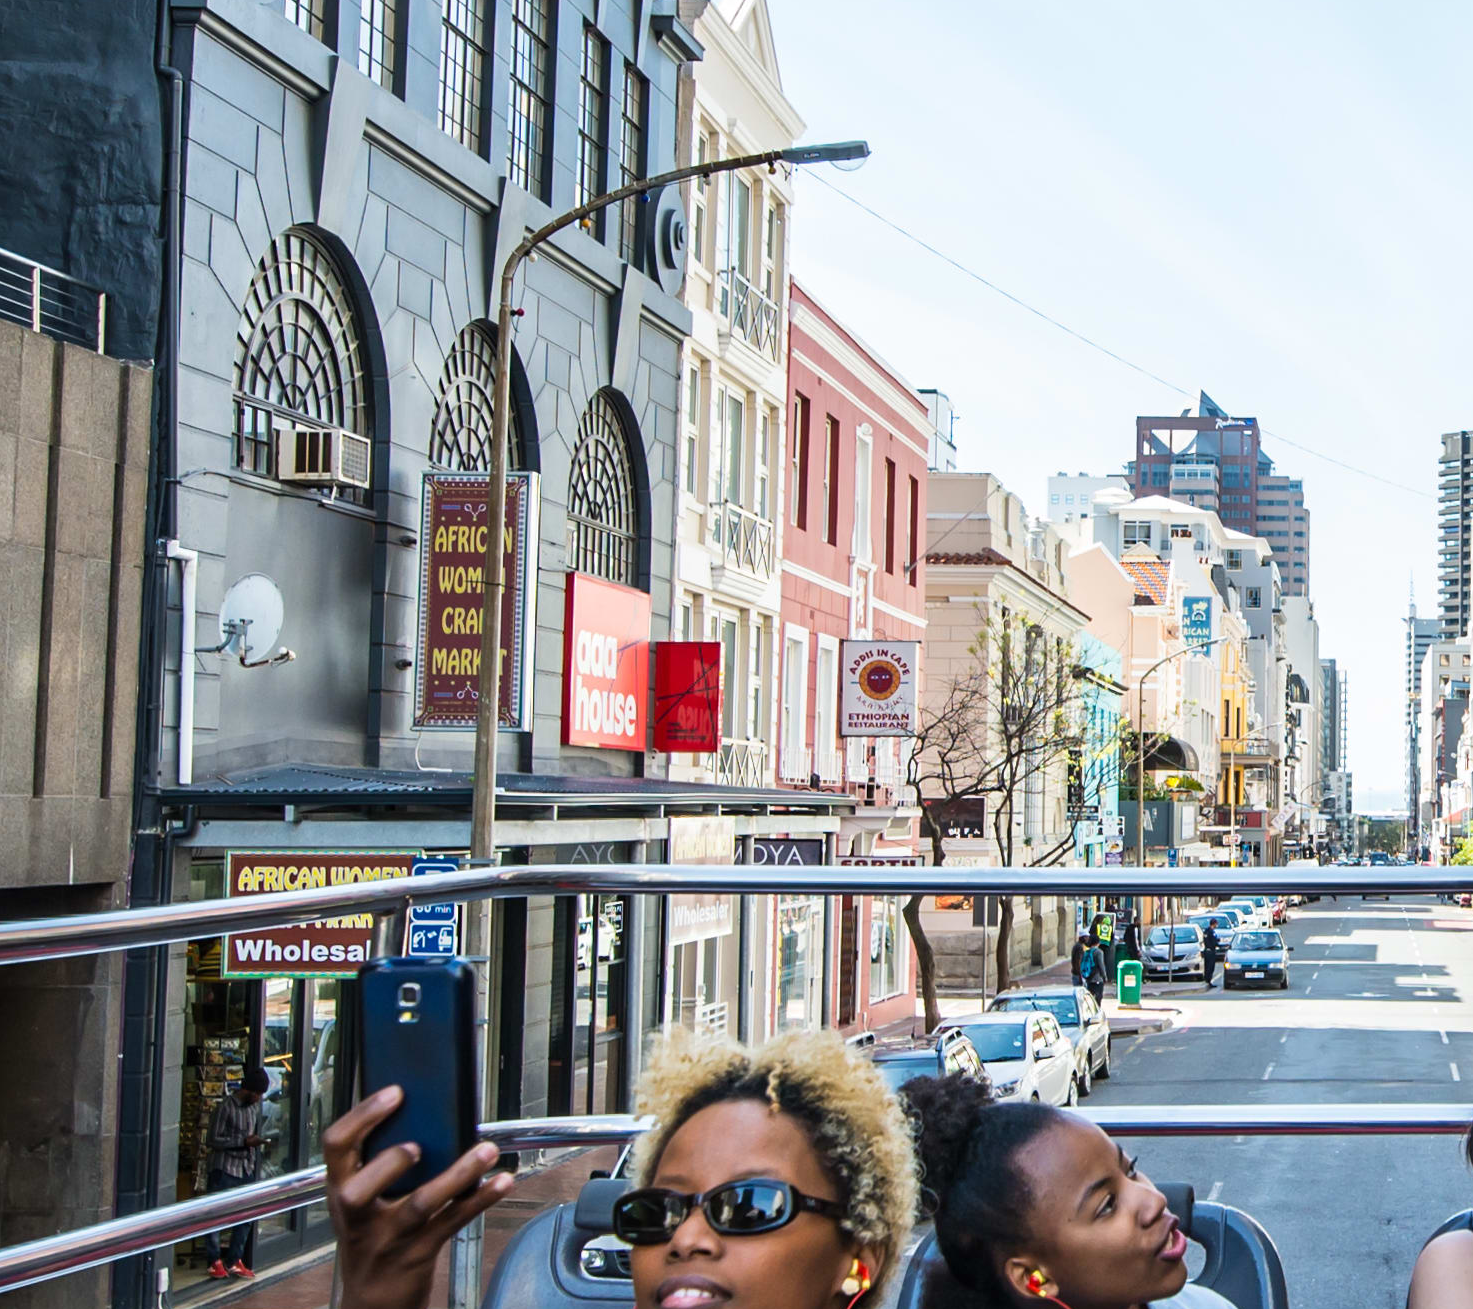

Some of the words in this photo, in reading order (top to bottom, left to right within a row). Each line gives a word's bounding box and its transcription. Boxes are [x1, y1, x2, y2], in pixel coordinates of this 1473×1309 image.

[434, 525, 513, 554] AFRICN
[438, 566, 506, 594] WOM
[432, 648, 508, 676] MARKT
[849, 650, 874, 675] ADDIS
[877, 649, 889, 657] IN
[890, 653, 911, 676] CAPE
[575, 675, 637, 736] house
[848, 712, 910, 721] ETHIOPIAN
[237, 866, 327, 891] AFRICAN
[235, 939, 371, 962] Wholesal
